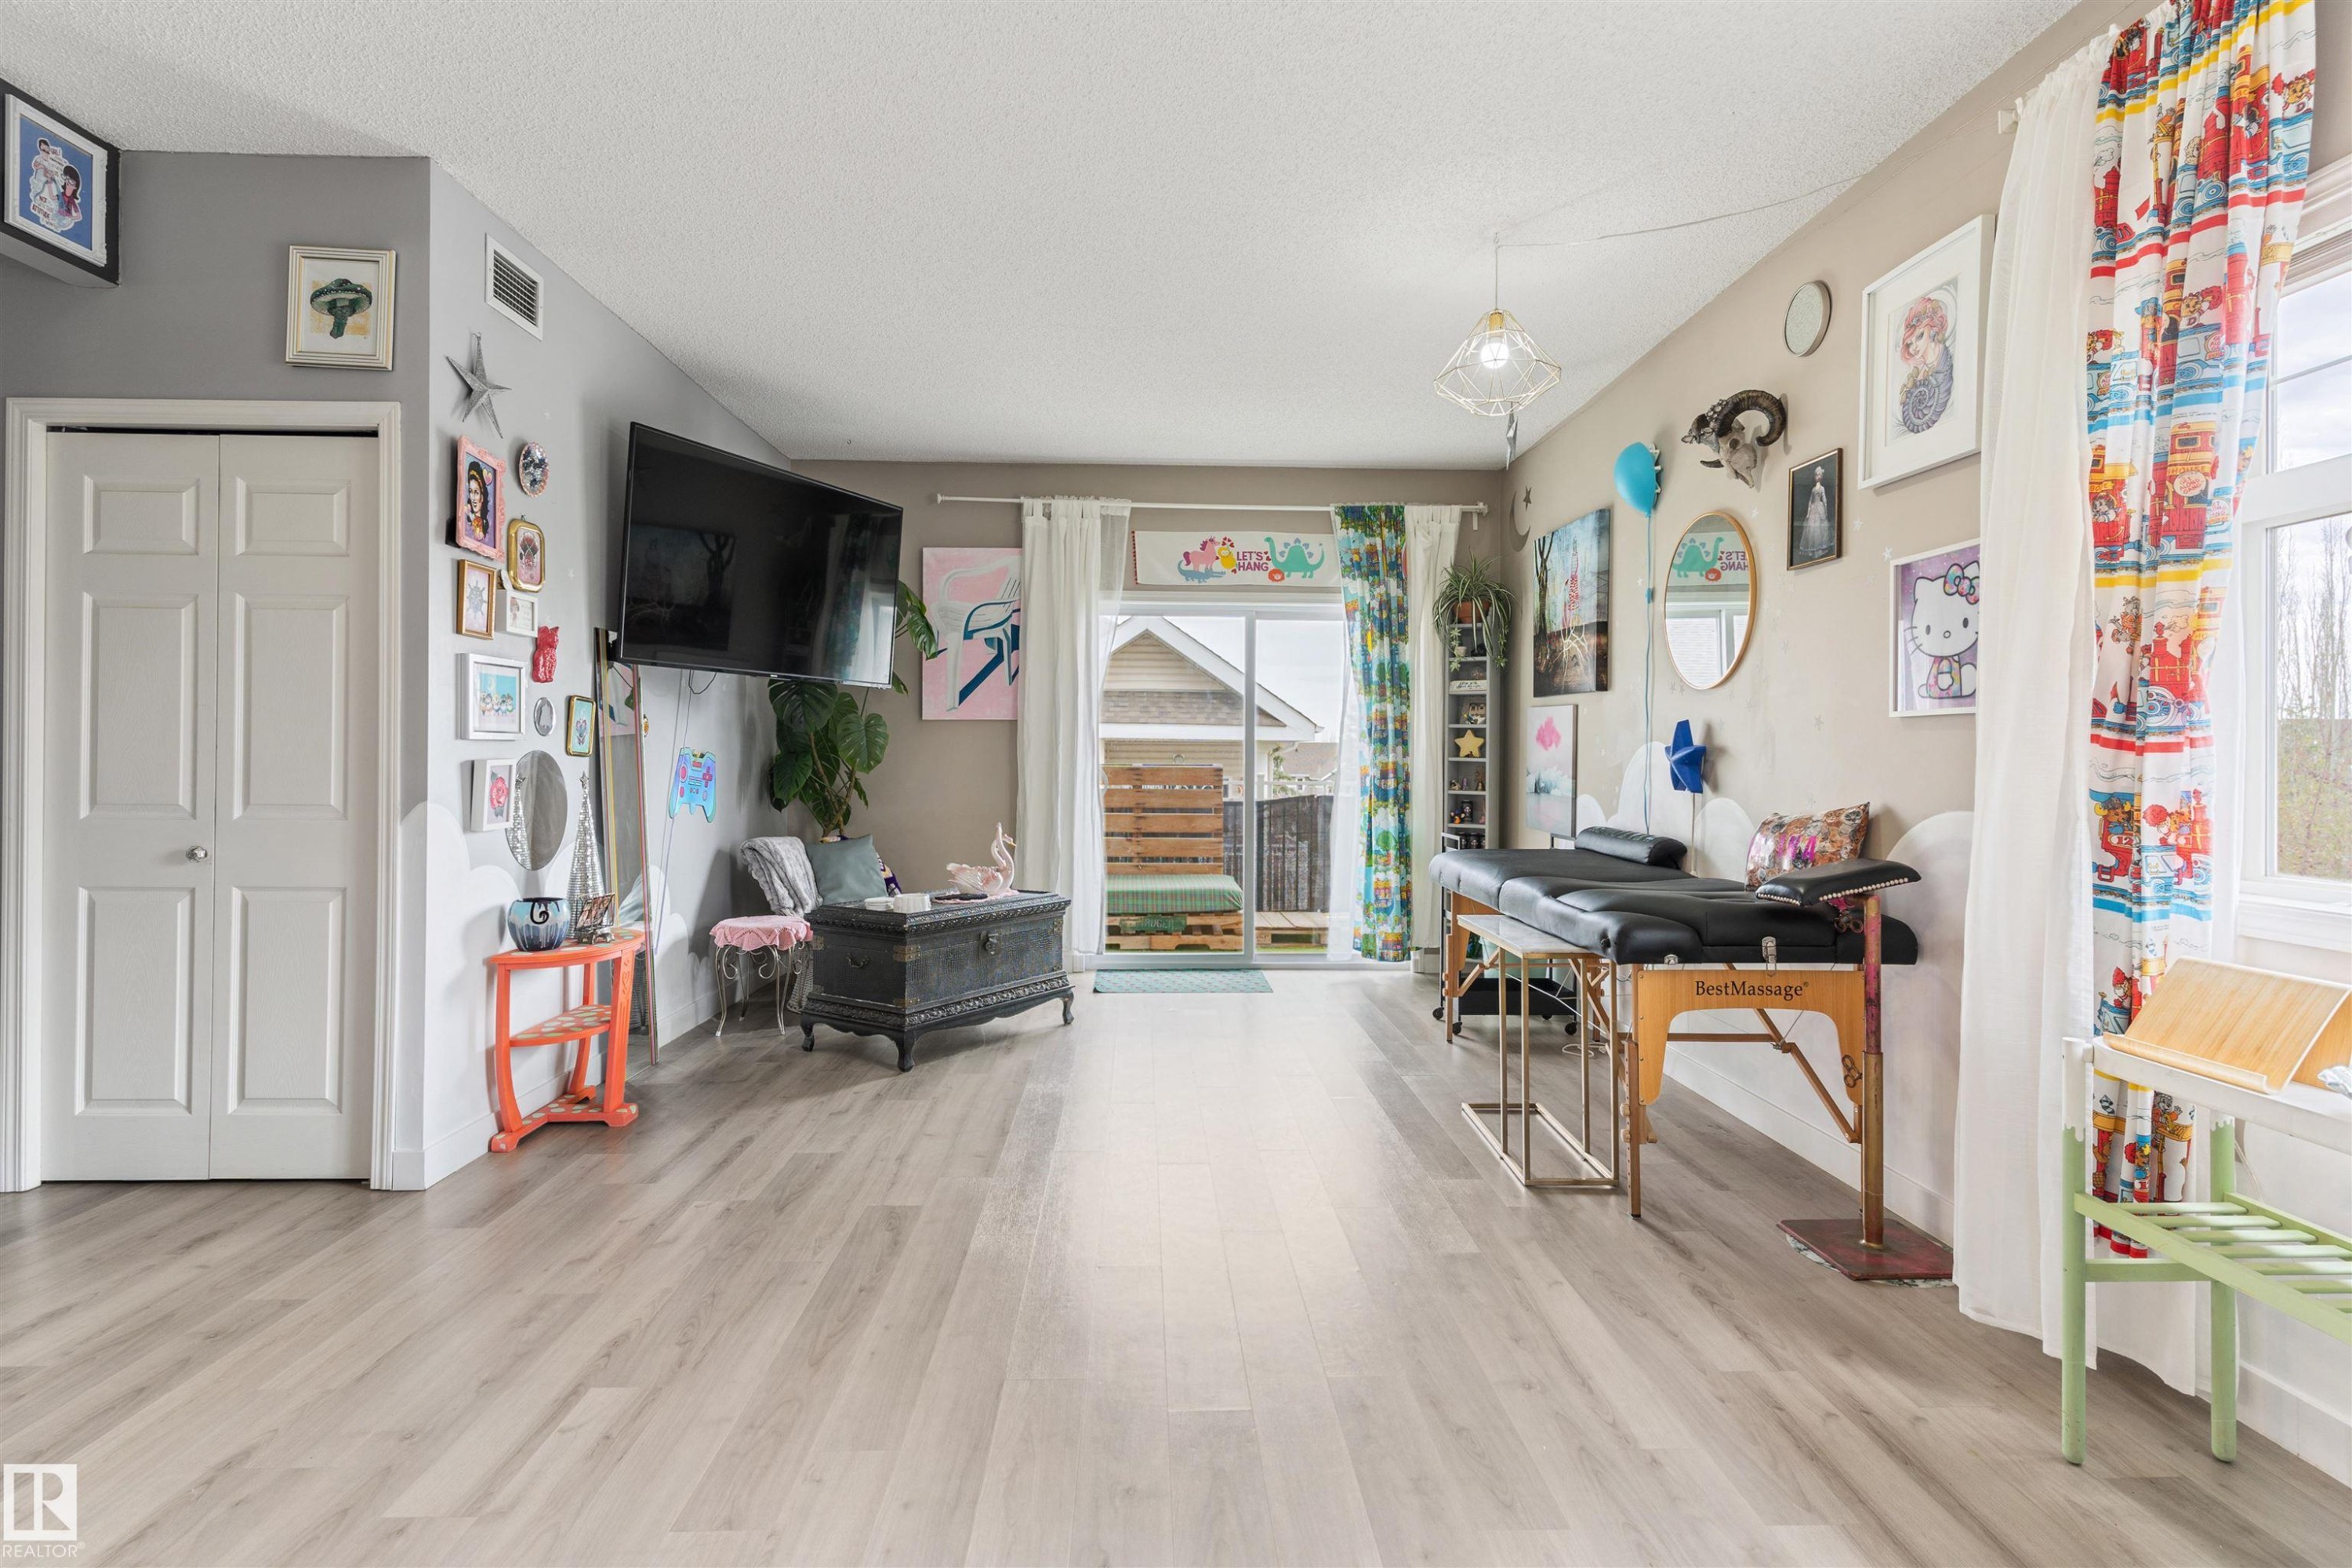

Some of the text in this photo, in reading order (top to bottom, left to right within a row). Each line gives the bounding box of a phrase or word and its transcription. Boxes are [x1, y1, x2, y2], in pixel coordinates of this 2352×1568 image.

[1236, 551, 1264, 561] LET'S
[1237, 561, 1269, 572] HANG
[2115, 836, 2134, 846] 12
